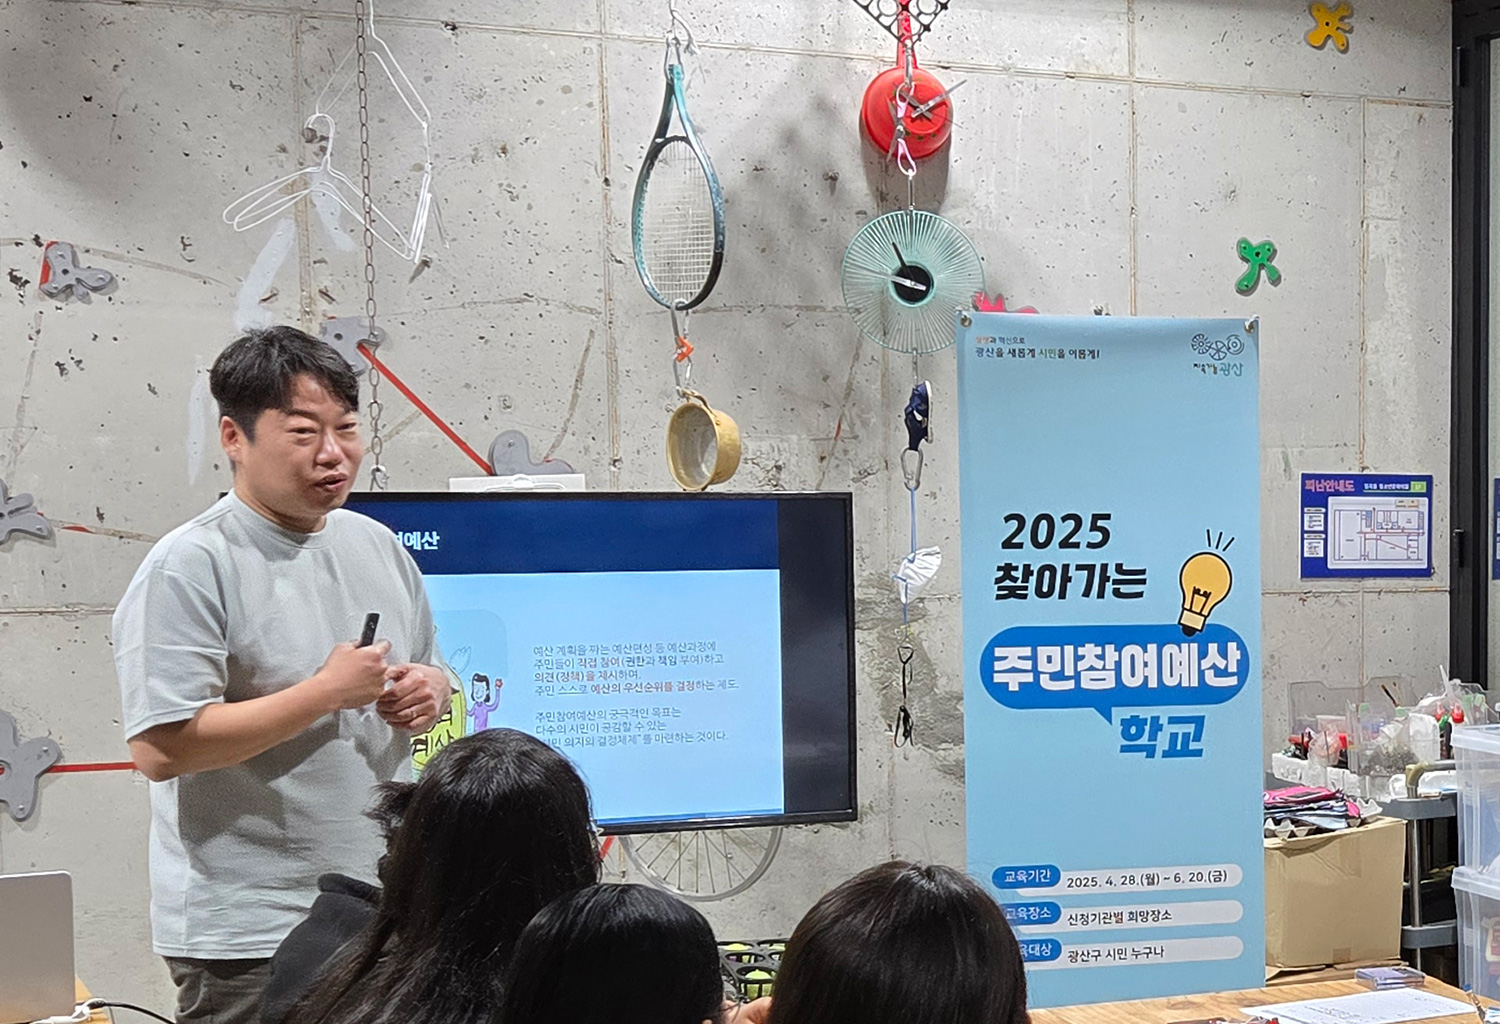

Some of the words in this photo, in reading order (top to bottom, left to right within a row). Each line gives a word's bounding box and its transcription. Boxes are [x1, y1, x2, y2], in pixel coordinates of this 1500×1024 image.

[975, 347, 1004, 358] 광산을
[1007, 347, 1036, 358] 새롭게
[1038, 348, 1065, 359] 시민을
[1304, 479, 1356, 492] 피난안내도
[1001, 512, 1112, 550] 2025
[994, 563, 1147, 600] 찾아가는
[534, 645, 554, 657] 예산
[589, 644, 610, 655] 짜는
[612, 643, 653, 655] 예산편성
[655, 642, 665, 653] 등
[667, 641, 716, 653] 예산과정에
[534, 658, 575, 670] 주민들이
[577, 657, 597, 668] 직접
[658, 655, 677, 666] 책임
[993, 642, 1241, 691] 주민참여예산
[534, 685, 554, 696] 주민
[558, 684, 588, 695] 스스로
[590, 683, 621, 694] 예산의
[623, 681, 673, 693] 우선순위를
[676, 680, 715, 692] 결정하는
[535, 710, 607, 723] 주민참여예산의
[609, 708, 649, 720] 궁극적인
[651, 707, 681, 718] 목표는
[535, 723, 566, 735] 다수의
[568, 723, 599, 734] 시민이
[602, 721, 632, 733] 공감할
[635, 721, 644, 731] 수
[647, 720, 667, 731] 있는
[564, 736, 595, 748] 의지의
[654, 732, 694, 744] 마련하는
[696, 731, 728, 742] 것이다.
[1119, 715, 1205, 759] 학교
[1004, 870, 1051, 883] 교육기간
[1067, 876, 1101, 889] 2025.
[1105, 875, 1117, 887] 4.
[1120, 872, 1160, 887] 28.(월)
[1173, 873, 1185, 884] 6.
[1188, 870, 1228, 884] 20.(금)
[1005, 906, 1052, 920] 교육장소
[1067, 911, 1124, 926] 신청기관별
[1127, 910, 1172, 923] 희망장소
[1020, 943, 1052, 957] 육대상
[1067, 950, 1102, 963] 광산구
[1105, 948, 1128, 960] 시민
[1131, 946, 1165, 959] 누구나
